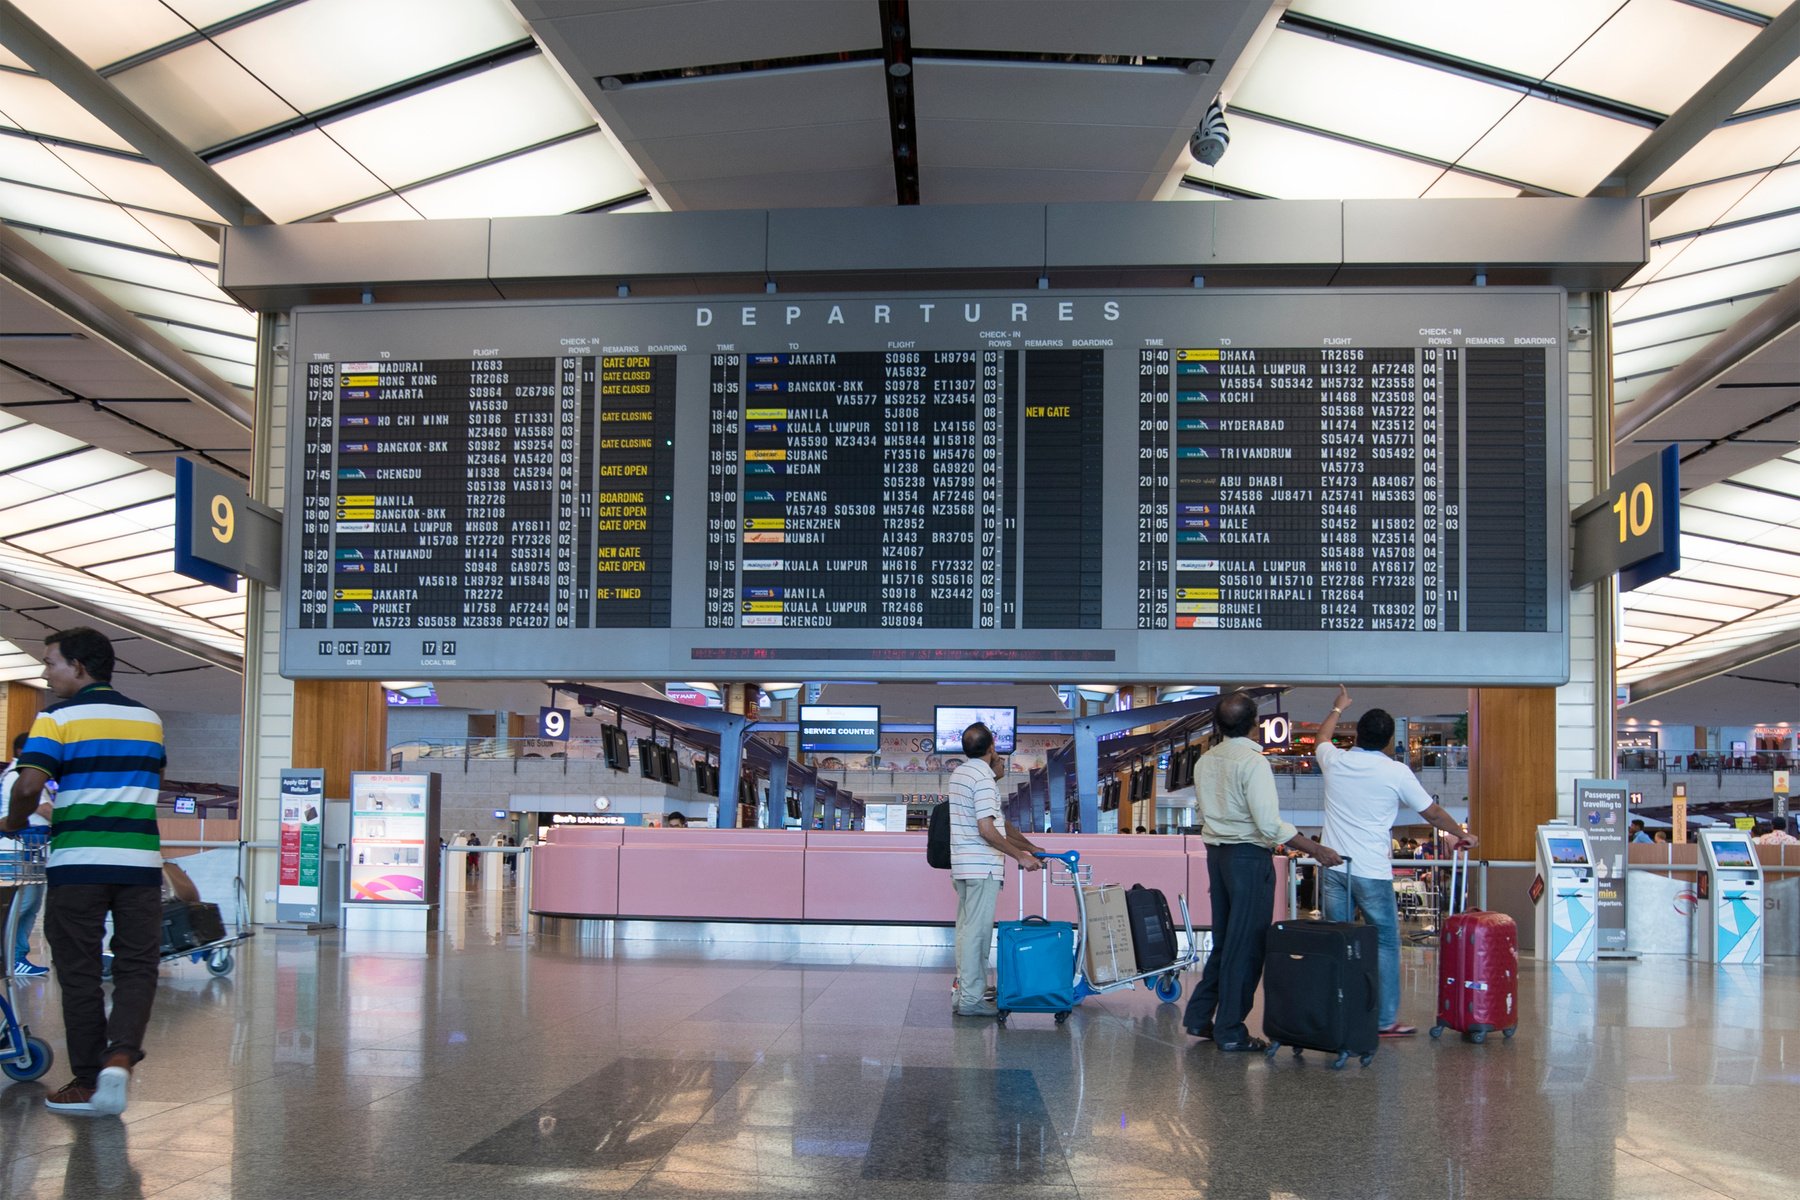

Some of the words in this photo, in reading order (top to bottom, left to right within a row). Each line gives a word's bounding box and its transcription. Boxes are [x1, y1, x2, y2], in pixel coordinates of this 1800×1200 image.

[697, 302, 1120, 327] DEPARTURES
[789, 354, 836, 365] JAKARTA
[1220, 350, 1255, 361] DHAKA
[379, 362, 422, 373] MADURAI
[604, 357, 624, 368] GATE
[627, 357, 650, 368] OPEN
[1220, 364, 1255, 375] KUALA
[1264, 364, 1306, 374] LUMPUR
[378, 376, 404, 387] HONG
[412, 375, 436, 385] KONG
[603, 371, 622, 380] GATE
[623, 371, 650, 380] CLOSED
[378, 388, 423, 400] JAKARTA
[603, 385, 622, 394] GATE
[623, 385, 650, 394] CLOSED
[1220, 392, 1254, 402] KOCHI
[788, 408, 828, 419] MANILA
[1026, 406, 1044, 417] NEW
[1047, 406, 1070, 417] GATE
[378, 416, 390, 426] HO
[397, 415, 414, 426] CHI
[423, 414, 448, 425] MINH
[602, 412, 622, 421] GATE
[622, 412, 652, 421] CLOSING
[1220, 419, 1284, 430] HYDERABAD
[787, 422, 821, 433] KUALA
[829, 422, 870, 432] LUMPUR
[602, 439, 620, 448] GATE
[621, 439, 652, 448] CLOSING
[786, 450, 828, 460] SUBANG
[1220, 448, 1292, 458] TRIVANDRUM
[376, 468, 421, 479] CHENGDU
[601, 465, 622, 476] GATE
[624, 465, 647, 476] OPEN
[786, 464, 820, 474] MEDAN
[1220, 476, 1241, 486] ABU
[1249, 476, 1282, 486] DHABI
[376, 495, 414, 506] MANILA
[600, 492, 644, 503] BOARDING
[786, 491, 827, 502] PENANG
[600, 506, 621, 517] GATE
[623, 506, 646, 517] OPEN
[1220, 504, 1255, 515] DHAKA
[1613, 482, 1653, 543] 10
[211, 495, 234, 543] 9
[786, 518, 840, 529] SHENZHEN
[1220, 518, 1248, 529] MALE
[375, 522, 406, 533] KUALA
[414, 522, 452, 532] LUMPUR
[600, 520, 621, 530] GATE
[623, 520, 646, 530] OPEN
[785, 532, 824, 543] MUMBAI
[1220, 532, 1270, 543] KOLKATA
[374, 549, 432, 560] KATHMANDU
[599, 547, 617, 558] NEW
[619, 547, 640, 558] GATE
[373, 563, 397, 573] BALI
[599, 561, 620, 571] GATE
[622, 561, 646, 571] OPEN
[785, 560, 818, 571] KUALA
[827, 560, 867, 570] LUMPUR
[1220, 560, 1255, 571] KUALA
[1264, 561, 1306, 572] LUMPUR
[373, 589, 418, 600] JAKARTA
[784, 587, 825, 598] MANILA
[1220, 588, 1311, 600] TIRUCHIRAPALI
[372, 603, 411, 613] PHUKET
[784, 601, 818, 612] KUALA
[826, 602, 866, 612] LUMPUR
[1220, 602, 1260, 614] BRUNEI
[784, 614, 832, 626] CHENGDU
[1220, 616, 1262, 628] SUBANG
[545, 711, 564, 737] 9
[1260, 717, 1288, 744] 10
[1584, 791, 1621, 800] Passengers
[1630, 793, 1642, 803] 11
[1583, 801, 1614, 810] travelling
[1599, 889, 1617, 898] mins
